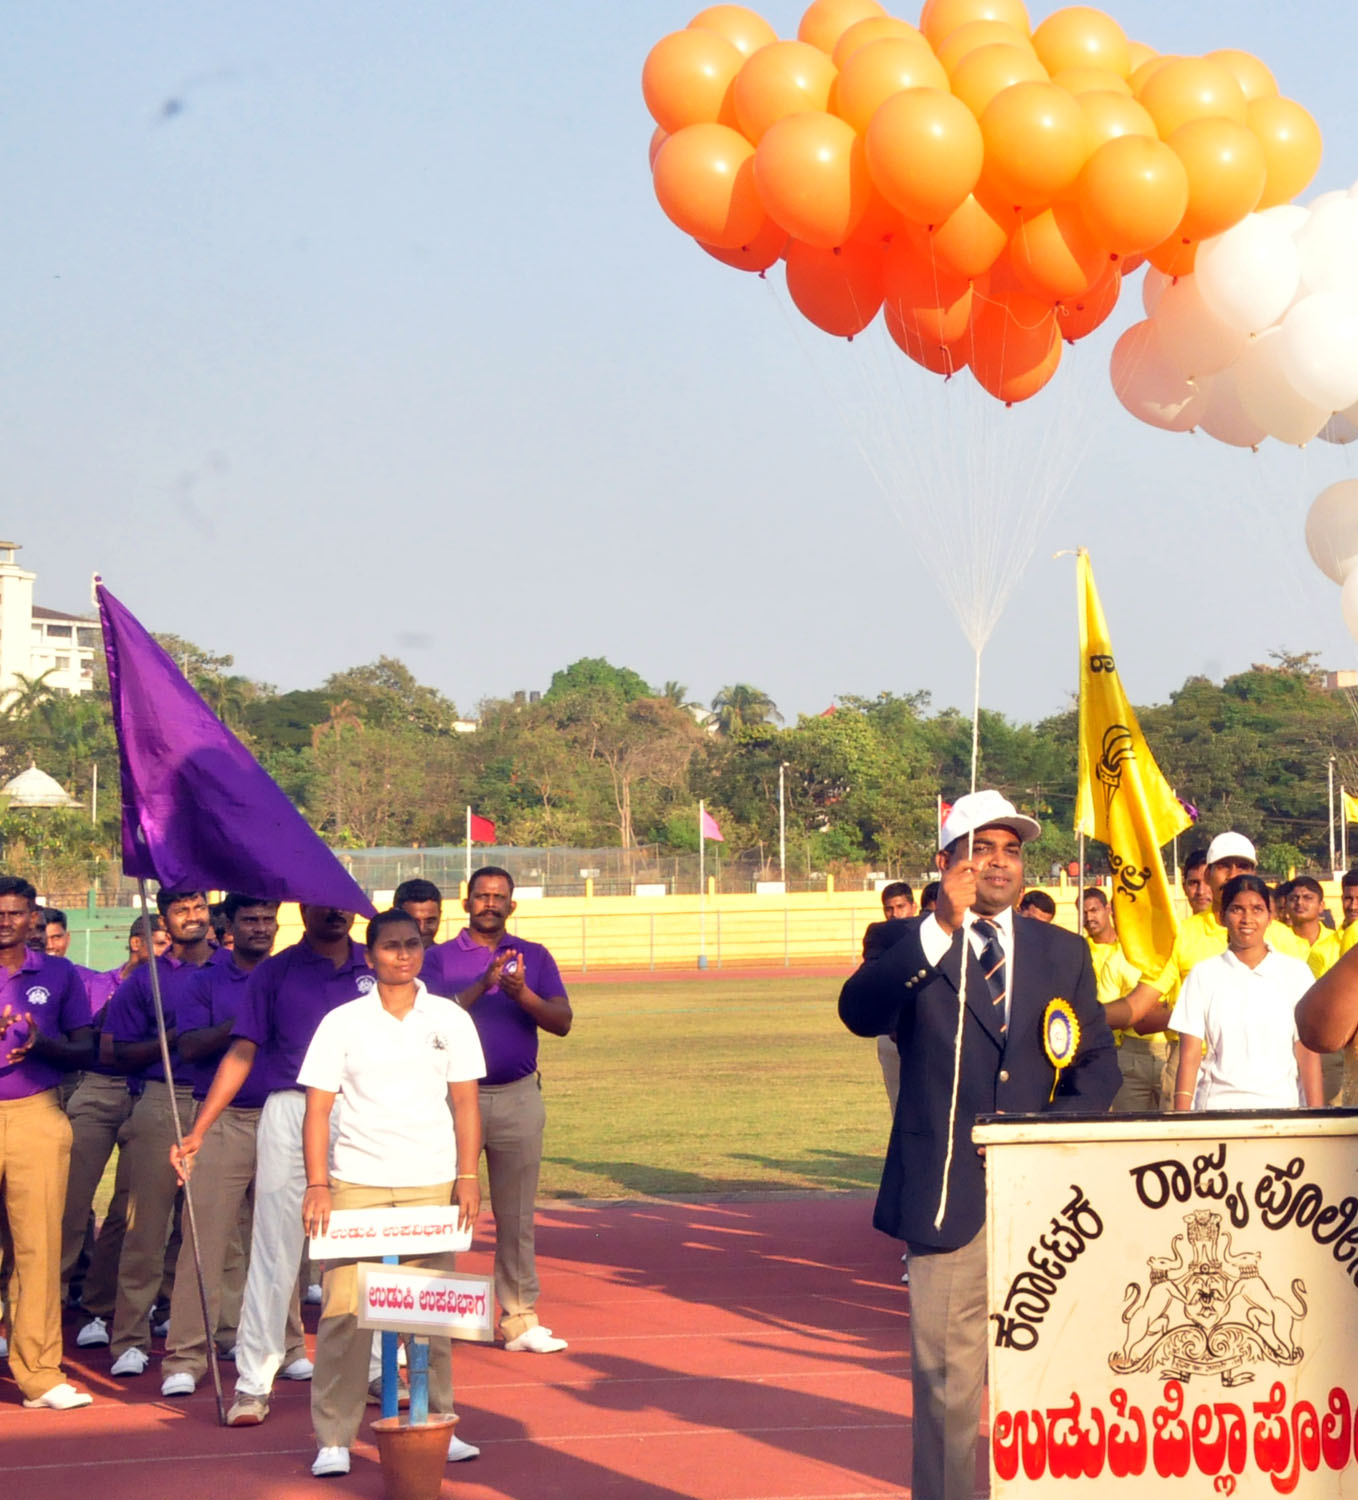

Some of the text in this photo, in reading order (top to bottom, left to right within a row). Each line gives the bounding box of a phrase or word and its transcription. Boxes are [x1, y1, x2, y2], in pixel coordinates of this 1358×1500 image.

[1129, 1143, 1250, 1228] ರಾಜ್ಯ
[369, 1285, 487, 1317] ಉಡುಪಿ ಉಪವಿಭಾಗ
[992, 1387, 1148, 1480] ಉಡುಪಿ
[1153, 1379, 1247, 1497] ಜಿಲ್ಲಾ
